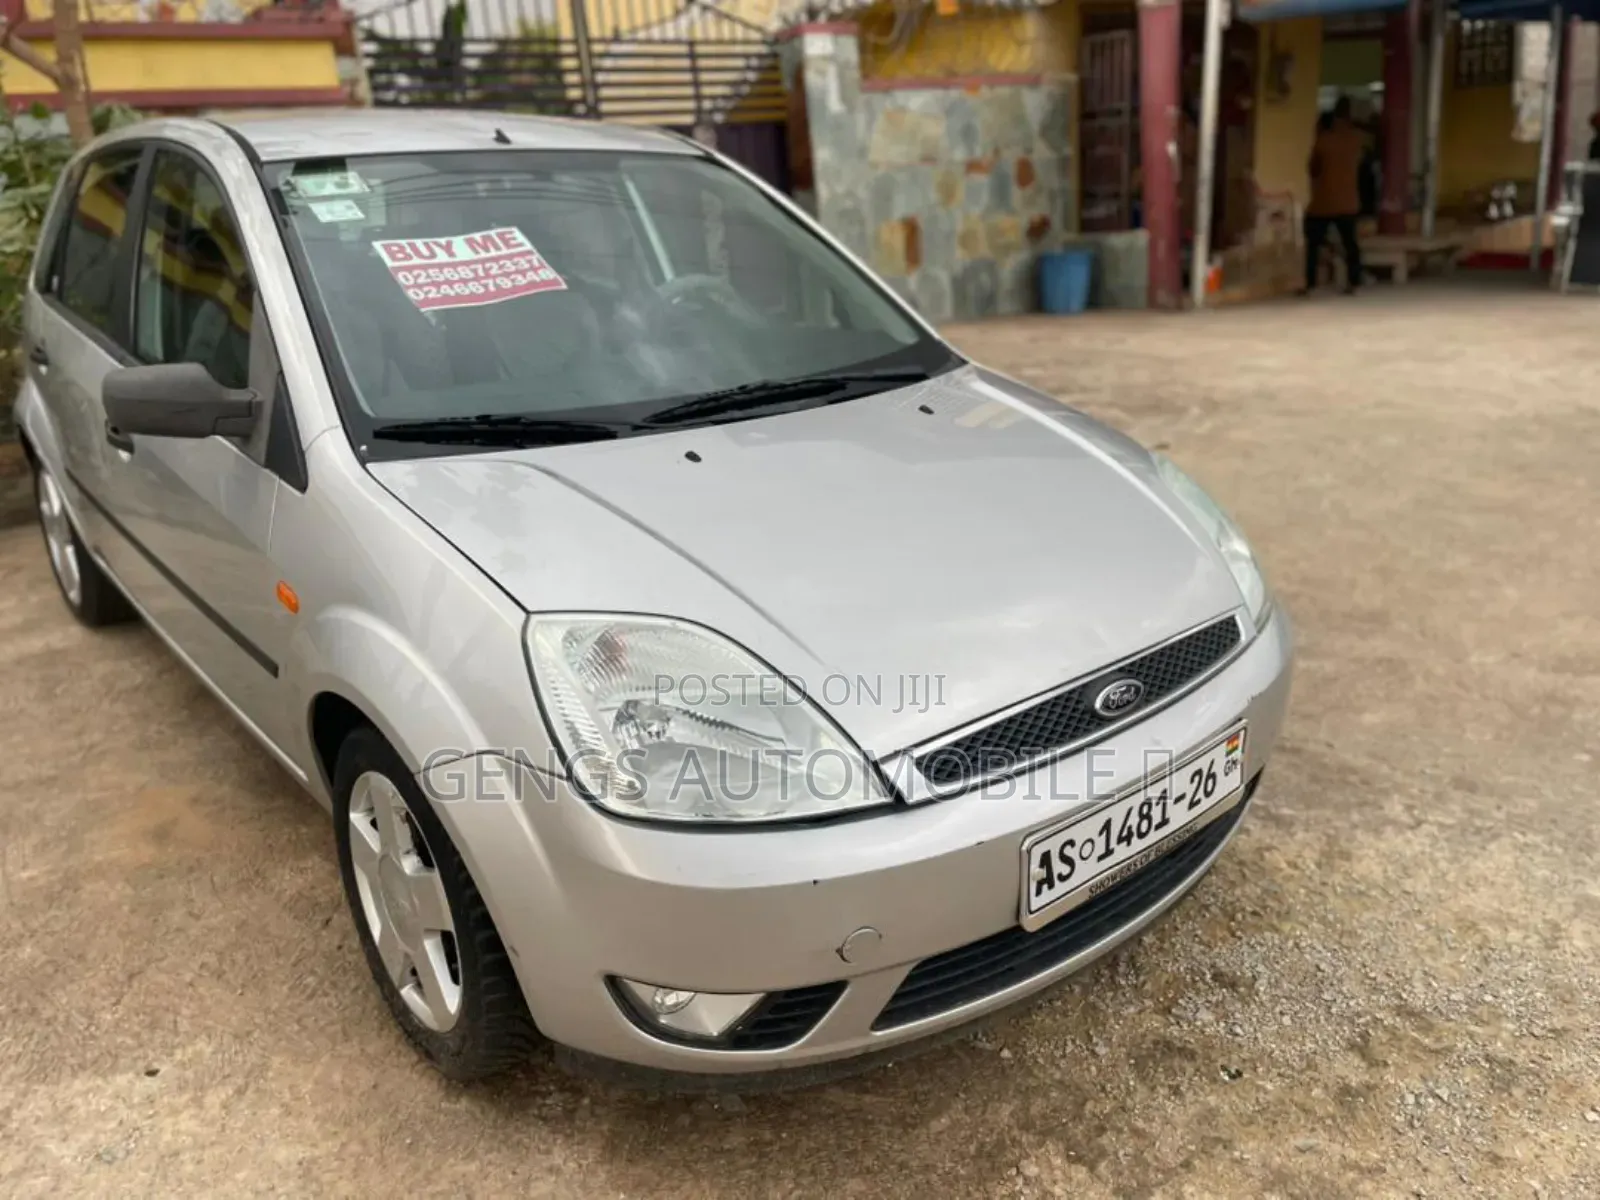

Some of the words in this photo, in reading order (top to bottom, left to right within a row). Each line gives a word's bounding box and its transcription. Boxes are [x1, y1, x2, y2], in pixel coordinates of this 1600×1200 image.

[380, 239, 457, 263] BUY
[464, 230, 527, 255] ME
[1108, 685, 1136, 709] Ford
[1035, 837, 1076, 898] AS
[1098, 758, 1217, 863] 1481-26
